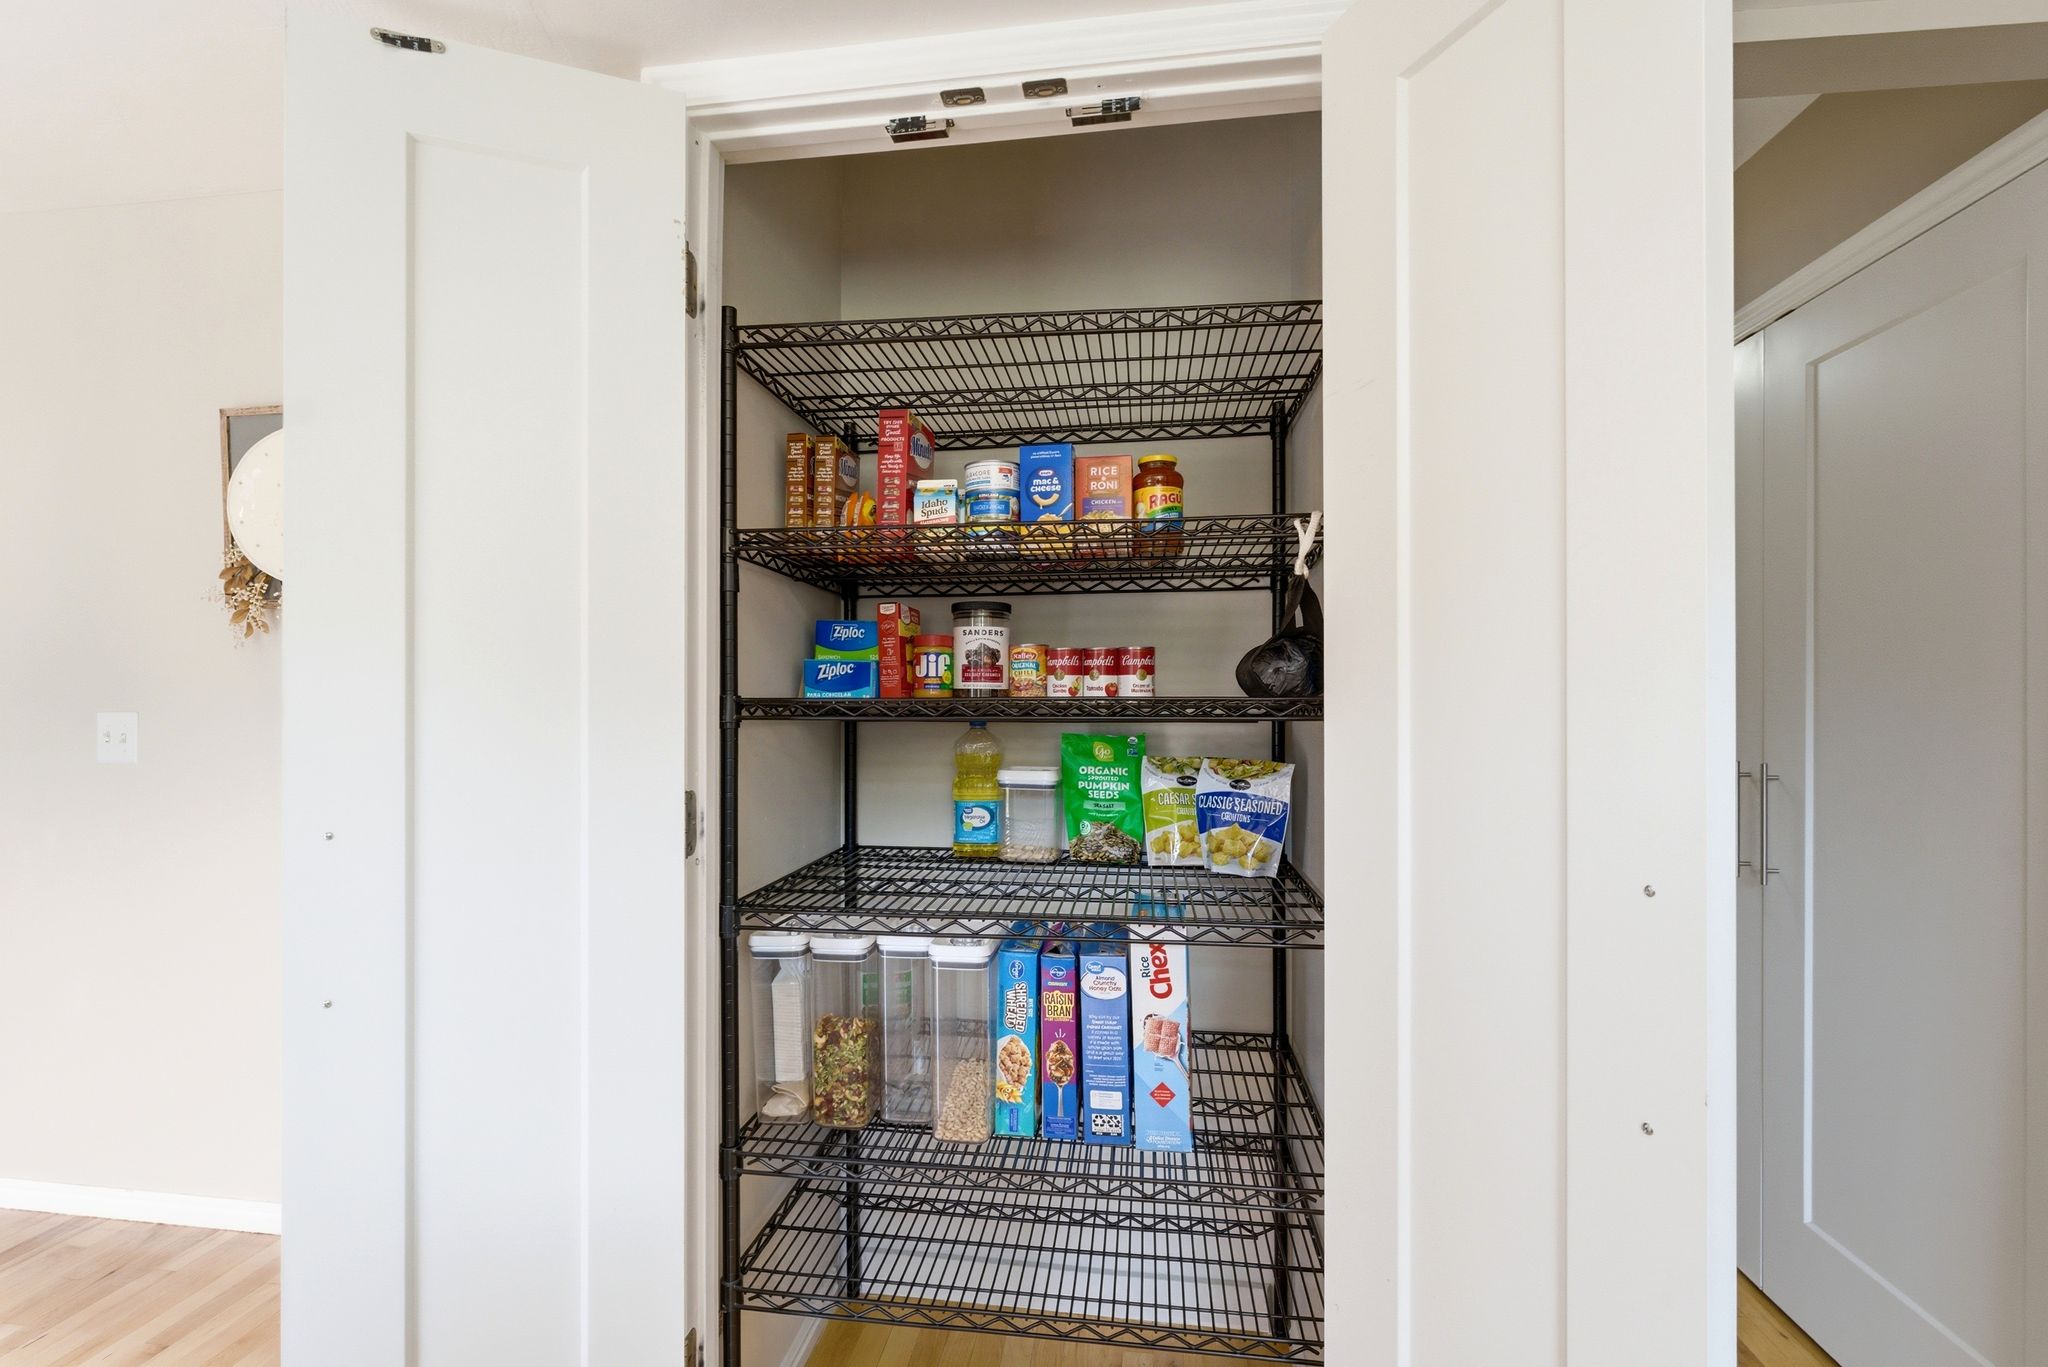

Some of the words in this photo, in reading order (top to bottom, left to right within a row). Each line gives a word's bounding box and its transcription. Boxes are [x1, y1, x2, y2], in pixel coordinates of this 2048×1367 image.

[1090, 466, 1118, 476] RICE
[1090, 481, 1118, 490] RONI
[921, 498, 948, 509] Idaho
[921, 507, 948, 518] Spuds
[833, 625, 865, 641] Ziploc
[962, 629, 1004, 637] SANDERS
[817, 662, 854, 681] Ziploc
[1079, 766, 1129, 776] ORGANIC
[1078, 781, 1130, 791] PUMPKIN
[1088, 790, 1120, 799] SEEDS
[1158, 793, 1191, 805] CAESAR
[1198, 795, 1233, 810] CLASSIC
[1234, 797, 1283, 816] SEASONED
[1220, 811, 1251, 823] CROUTONS
[1140, 956, 1151, 978] Rice
[1149, 943, 1173, 999] Chex
[1044, 992, 1073, 1005] RAISIN
[1004, 990, 1016, 1028] WHEAT
[1015, 983, 1027, 1032] SHREDDED
[1047, 1005, 1071, 1017] BRAN
